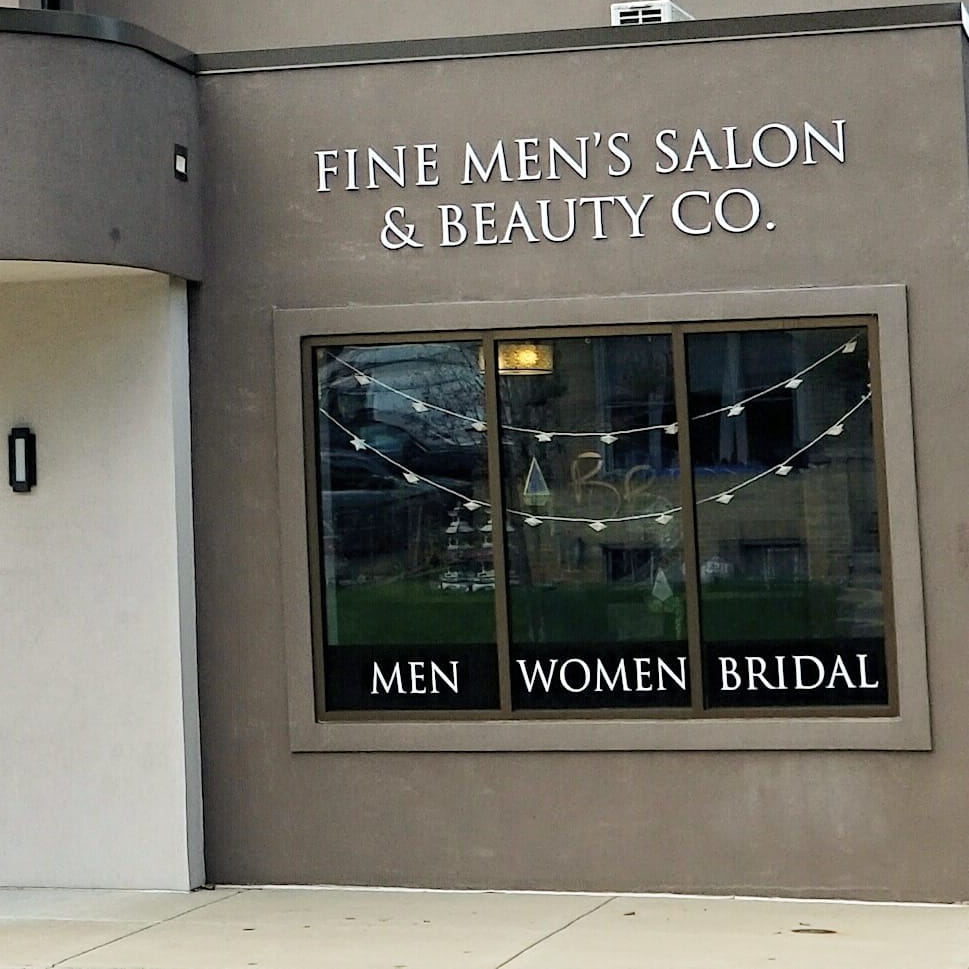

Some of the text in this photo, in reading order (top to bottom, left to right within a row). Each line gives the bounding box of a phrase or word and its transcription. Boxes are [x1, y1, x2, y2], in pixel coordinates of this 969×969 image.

[314, 119, 847, 193] FINE MEN'S SALON
[379, 188, 777, 250] & BEAUTY CO.
[370, 653, 880, 695] MEN WOMEN BRIDAL
